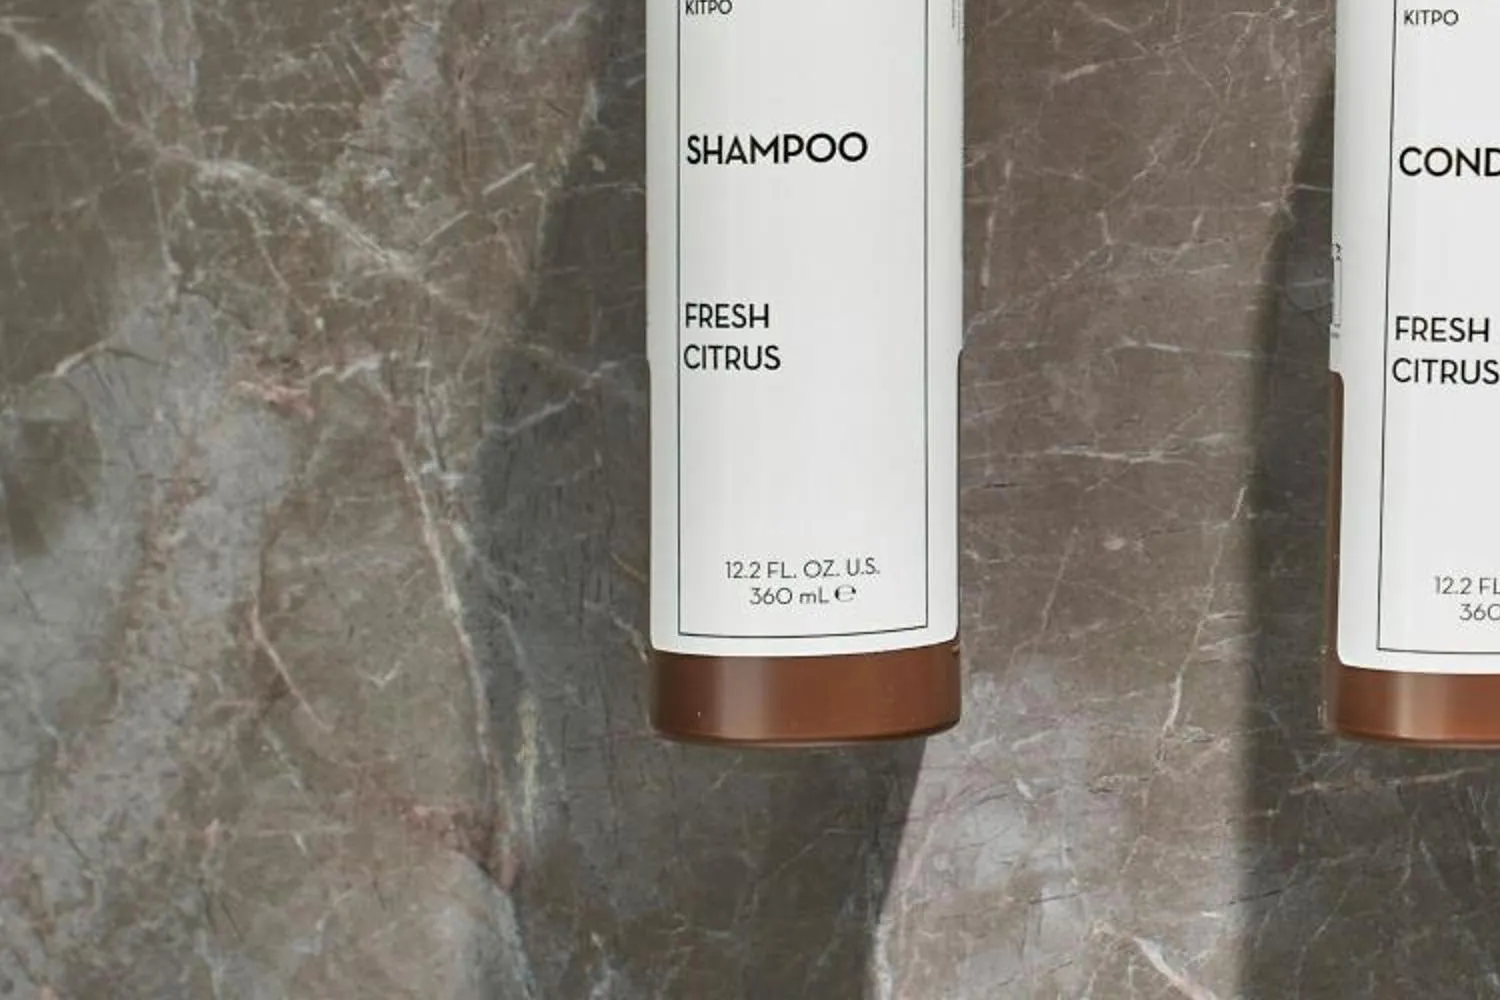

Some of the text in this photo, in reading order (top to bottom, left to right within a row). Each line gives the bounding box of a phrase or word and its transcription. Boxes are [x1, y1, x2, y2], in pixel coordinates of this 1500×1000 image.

[1404, 10, 1459, 26] ΚΙΤΡΟ
[687, 132, 868, 165] SHAMPOO
[685, 303, 770, 328] FRESH
[1395, 316, 1490, 343] FRESH
[684, 344, 782, 371] CITRUS
[1392, 357, 1500, 385] CITRUS
[726, 557, 881, 579] 12.2 FL. OZ. U.S.
[750, 587, 793, 605] 360
[799, 587, 830, 605] mL
[1435, 576, 1472, 595] 12.2
